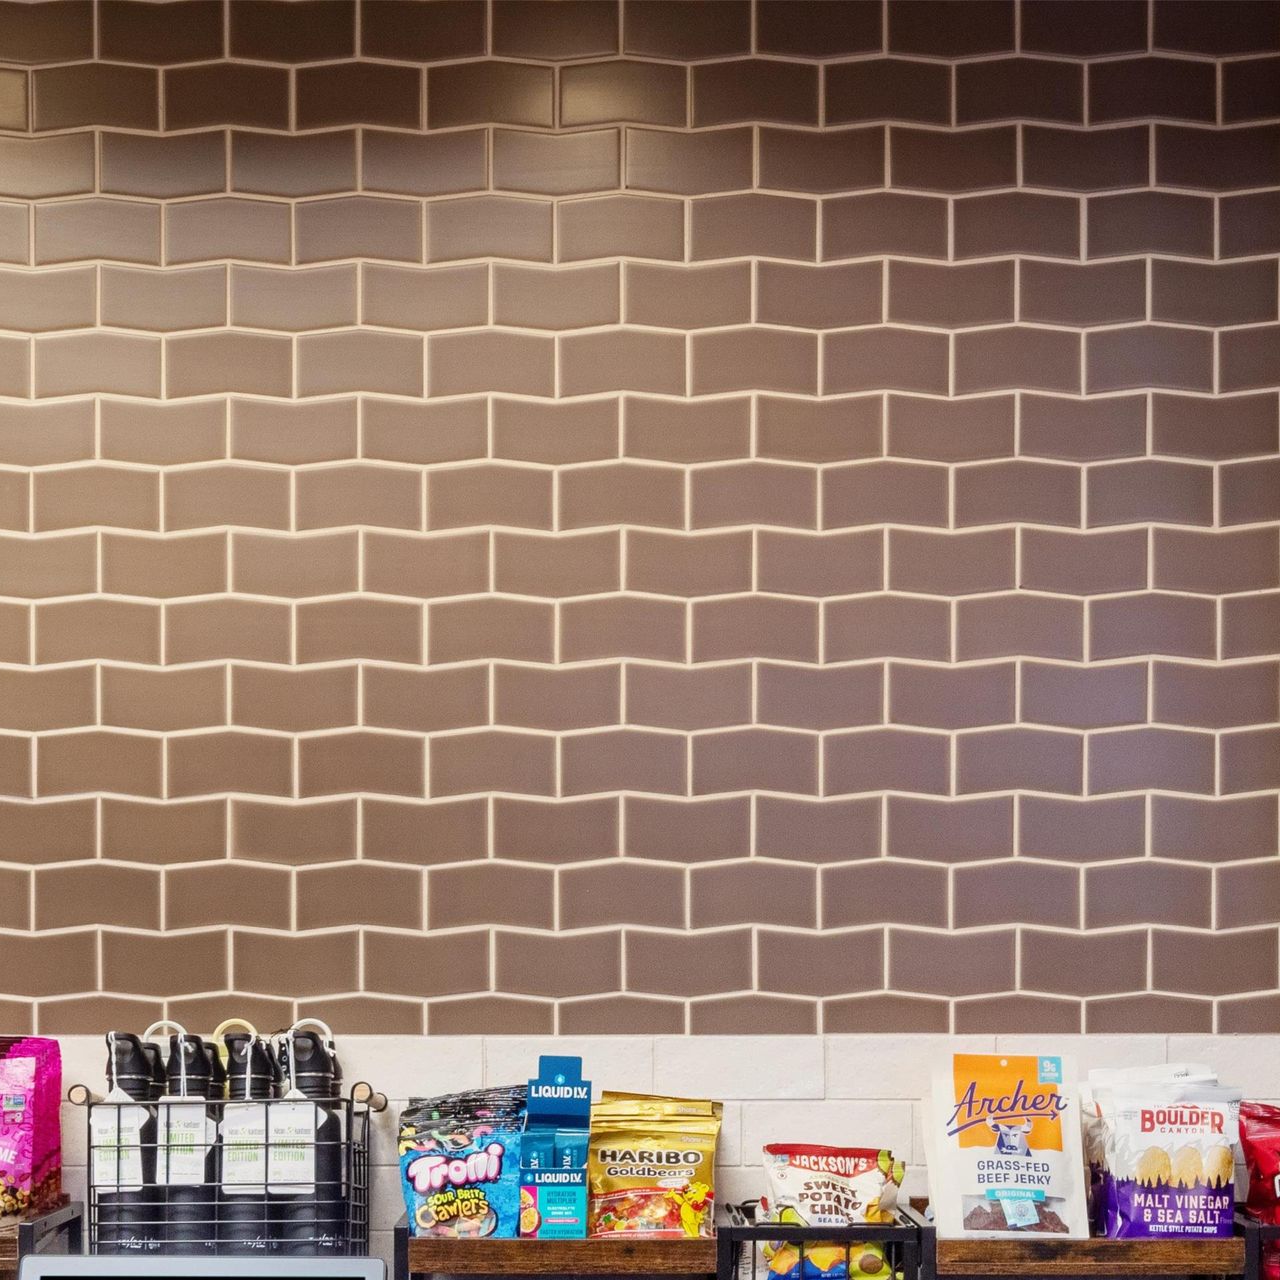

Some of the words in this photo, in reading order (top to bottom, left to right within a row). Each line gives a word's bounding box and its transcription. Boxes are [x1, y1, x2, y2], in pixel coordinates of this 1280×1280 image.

[531, 1085, 573, 1098] LIQUID
[573, 1086, 588, 1098] I.V.
[947, 1080, 1068, 1127] Archer
[1140, 1109, 1224, 1135] BOULDER
[1160, 1126, 1205, 1135] CANYON
[227, 1151, 258, 1162] EDITION
[273, 1151, 305, 1162] EDITION
[599, 1149, 702, 1165] HARIBO
[407, 1142, 505, 1193] Trolli
[606, 1166, 694, 1177] Goldbears
[792, 1155, 868, 1175] JACKSON'S
[977, 1159, 1051, 1174] GRASS-FED
[535, 1173, 569, 1183] LIQUID
[570, 1173, 582, 1183] I.V.
[977, 1172, 1011, 1185] BEEF
[1014, 1172, 1052, 1186] JERKY
[427, 1191, 455, 1206] SOUR
[457, 1188, 486, 1200] BRITE
[803, 1181, 858, 1198] SWEET
[995, 1189, 1037, 1199] ORIGINAL
[798, 1192, 862, 1210] POTATO
[1134, 1193, 1170, 1208] MALT
[1175, 1195, 1230, 1210] VINEGAR
[415, 1199, 489, 1229] Crawlers
[1143, 1210, 1152, 1222] &
[1157, 1210, 1183, 1223] SEA
[1189, 1210, 1221, 1225] SALT
[1149, 1224, 1168, 1233] KETTLE
[1168, 1225, 1184, 1233] STYLE
[1185, 1225, 1202, 1233] POTATO
[1203, 1225, 1218, 1234] CHIPS
